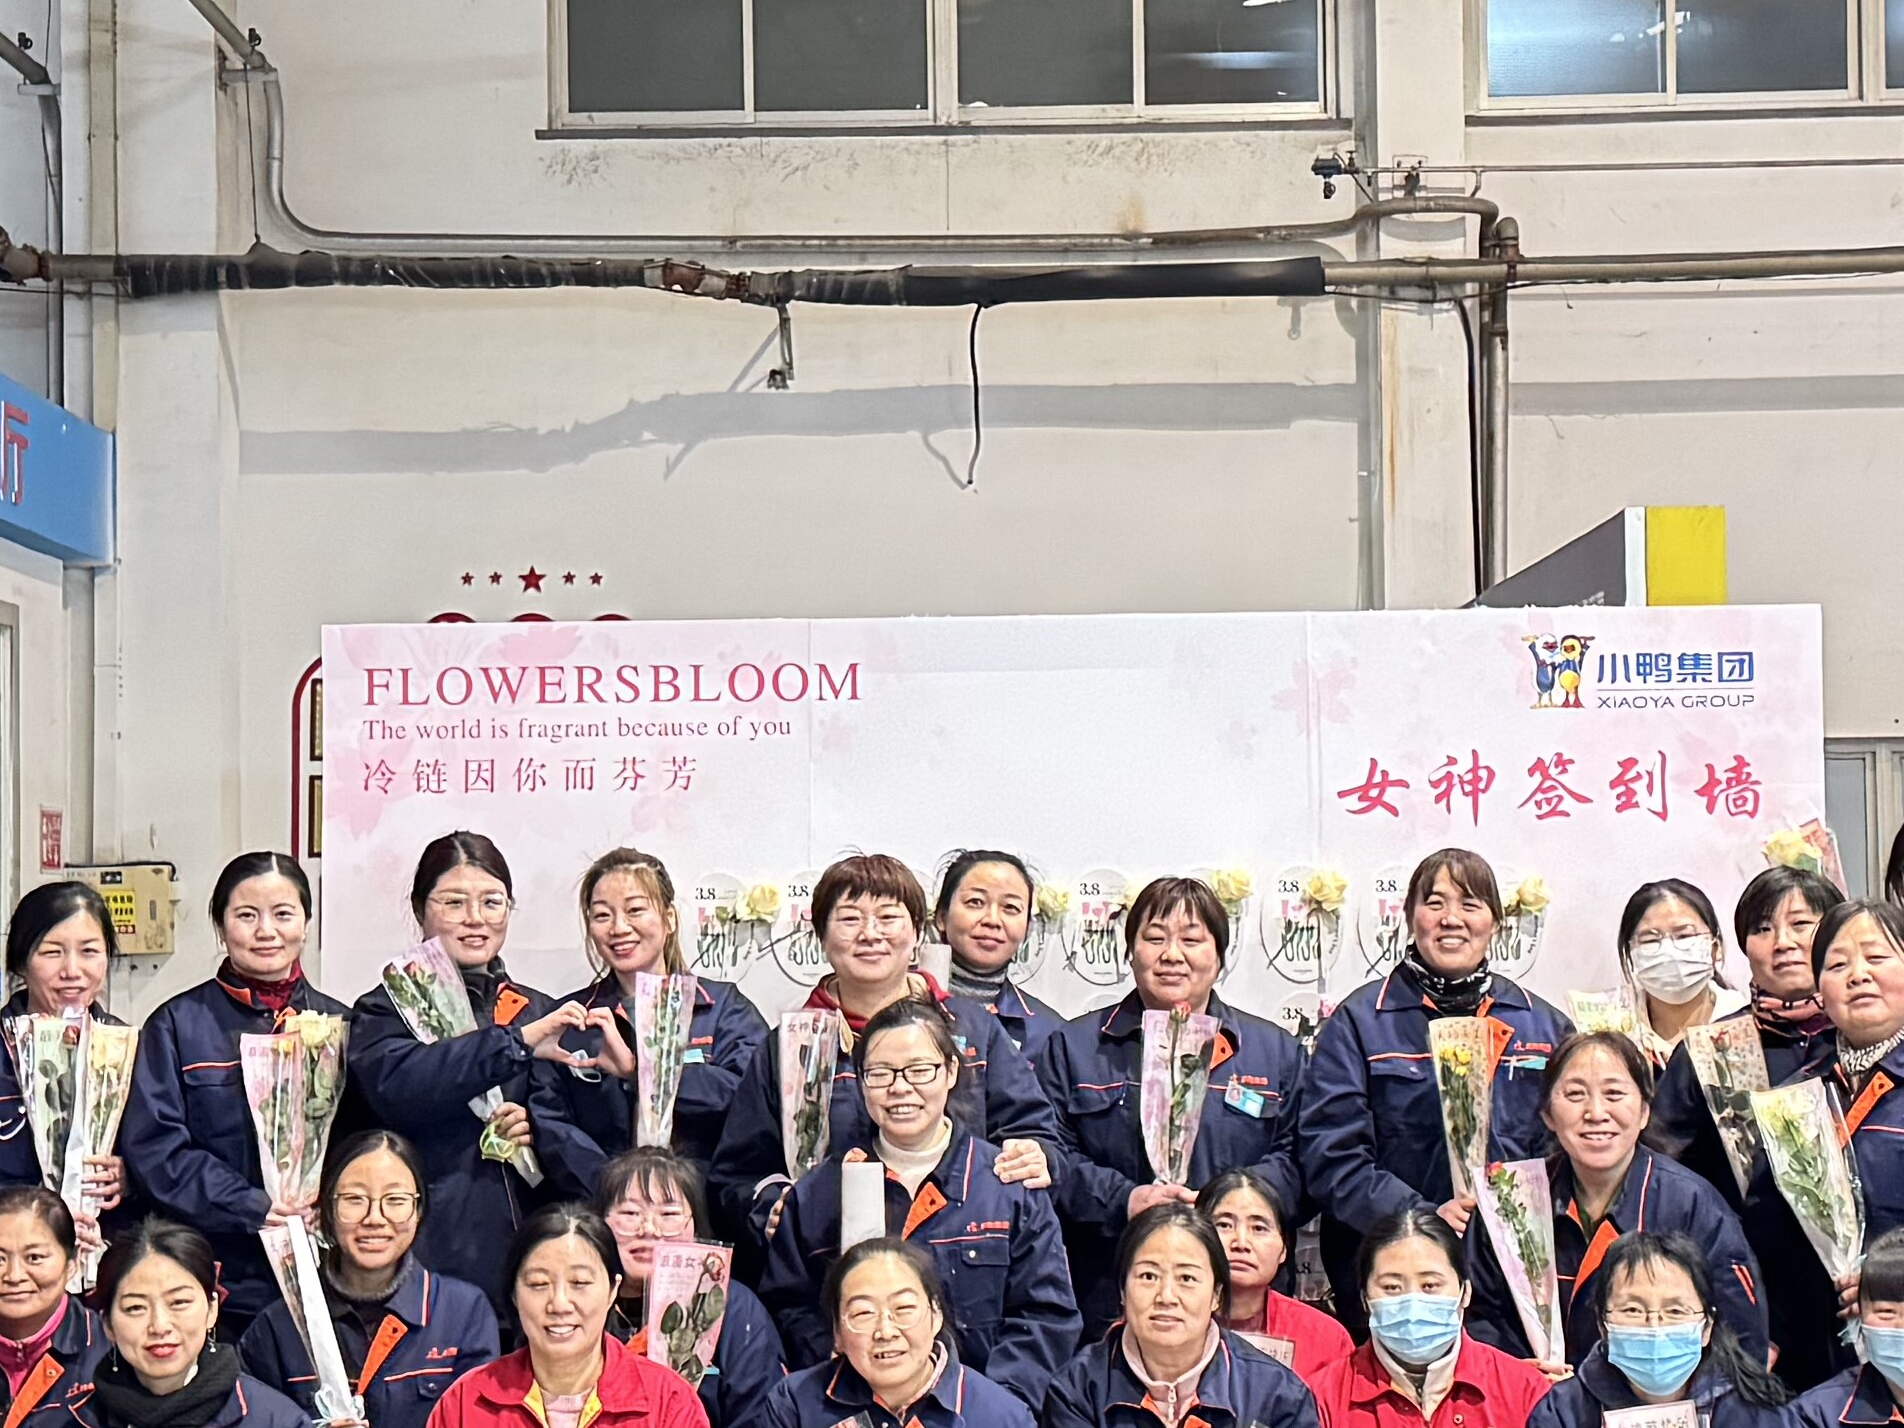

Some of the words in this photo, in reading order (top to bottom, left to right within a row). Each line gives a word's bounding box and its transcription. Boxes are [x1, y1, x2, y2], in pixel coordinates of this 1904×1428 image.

[1597, 651, 1755, 684] 小鸭集团
[363, 662, 864, 706] FLOWERSBLOOM
[1681, 694, 1755, 708] GROUP
[363, 719, 407, 740] The
[416, 718, 481, 740] world
[491, 717, 509, 739] is
[518, 718, 609, 744] fragrant
[618, 717, 709, 738] because
[717, 715, 743, 736] of
[749, 720, 792, 741] you
[363, 756, 697, 795] 冷链因你而芬芳
[1337, 748, 1763, 827] 女神签到墙
[788, 884, 809, 898] 3.8
[1080, 883, 1100, 896] 3.8
[1278, 880, 1299, 893] 3.8
[1375, 879, 1396, 893] 3.8
[695, 887, 716, 900] 3.8
